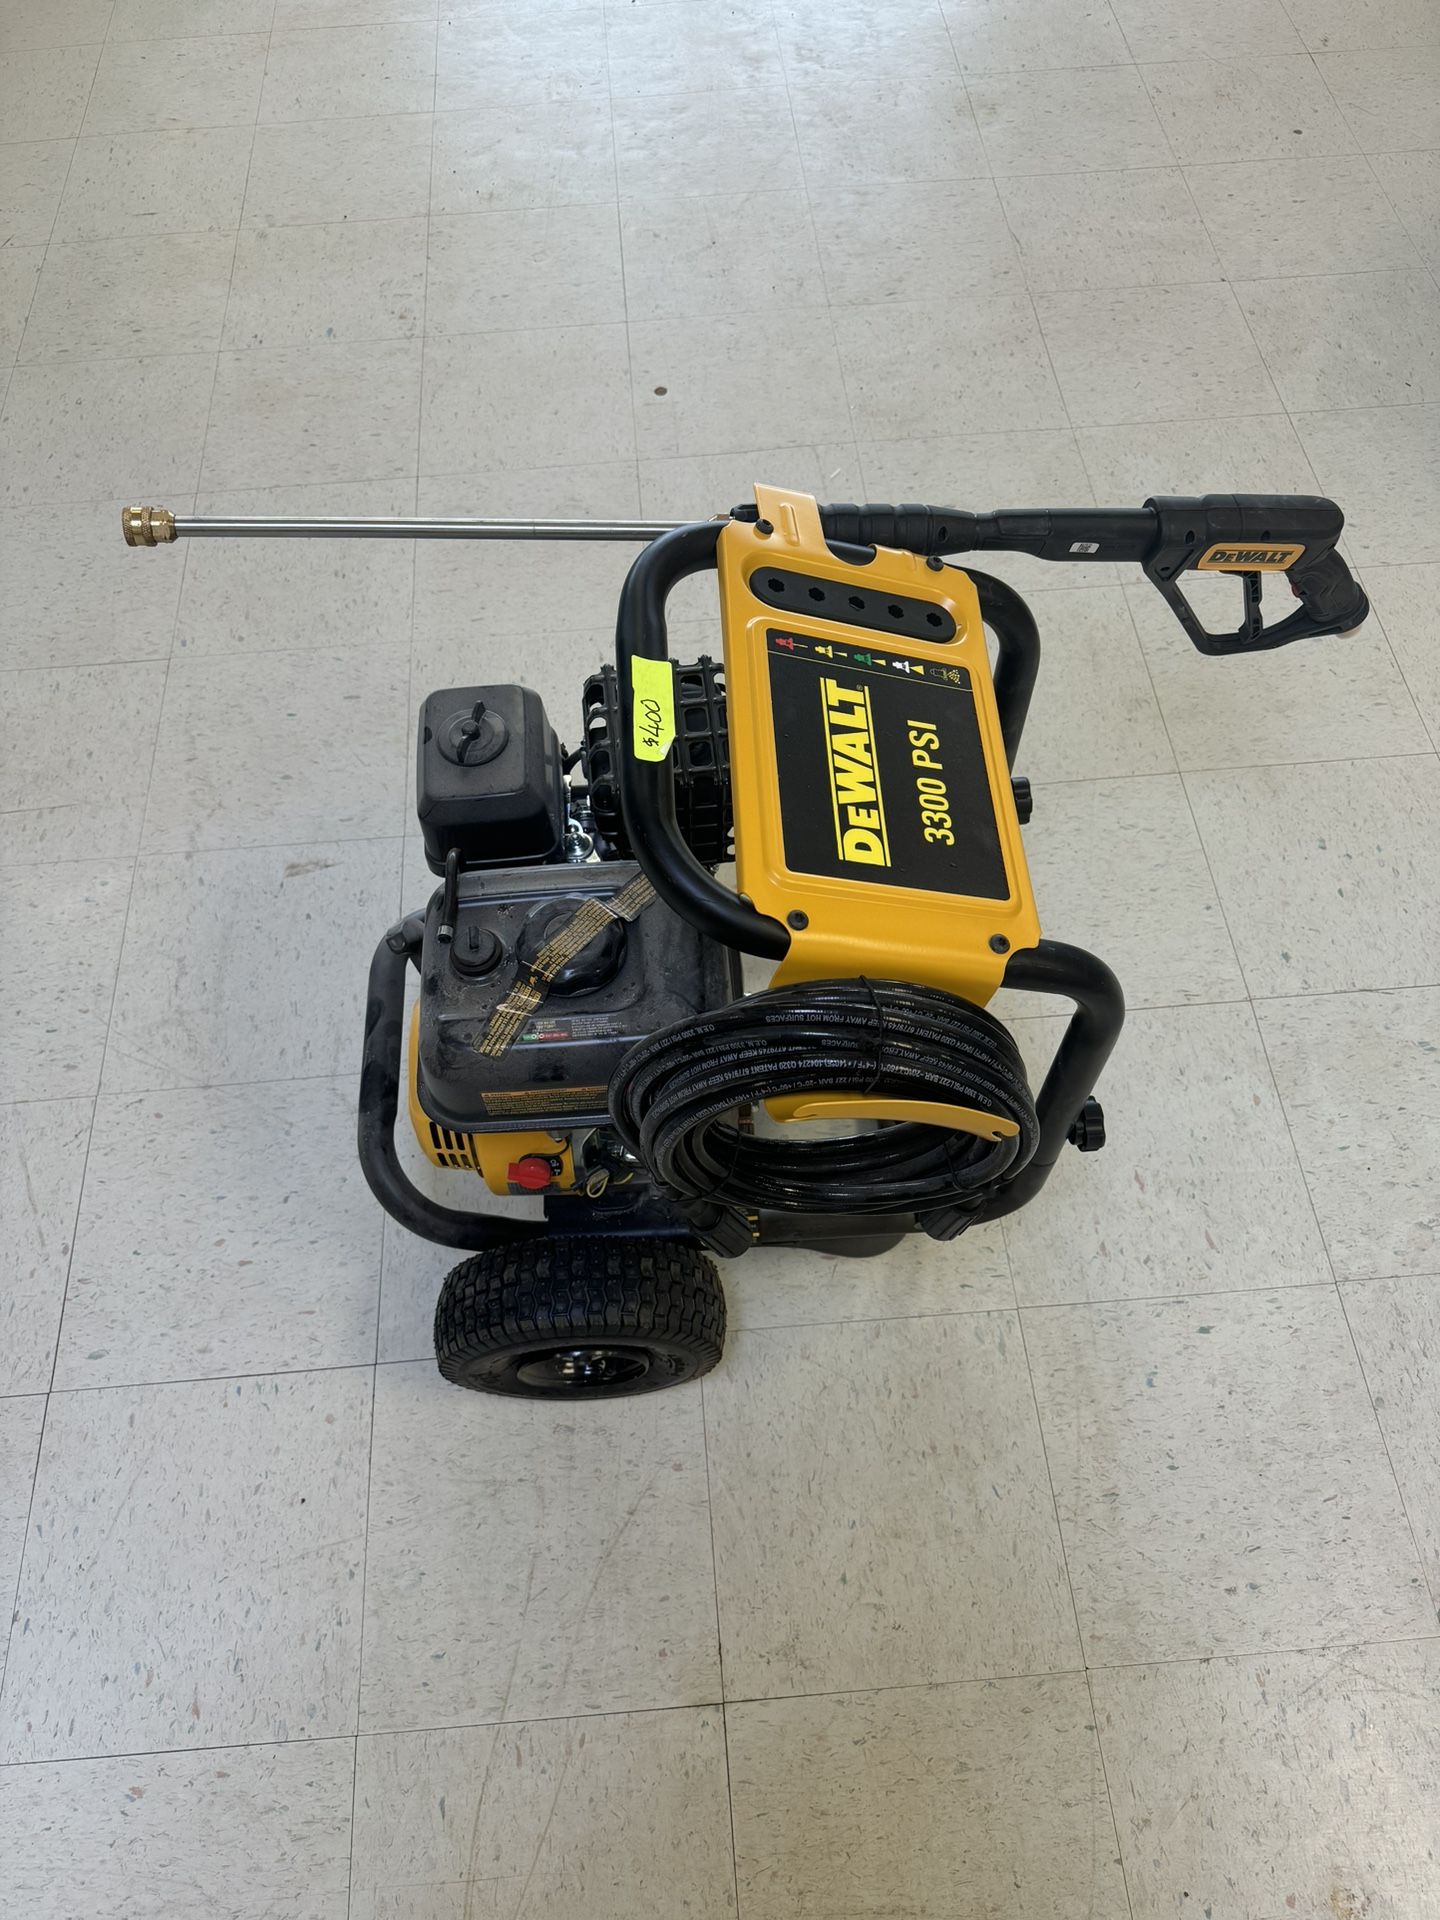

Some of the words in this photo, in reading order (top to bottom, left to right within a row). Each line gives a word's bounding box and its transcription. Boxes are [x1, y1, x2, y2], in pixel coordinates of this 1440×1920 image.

[1206, 550, 1294, 564] DEWALT
[639, 699, 664, 747] $400
[907, 719, 944, 770] PSI
[824, 678, 887, 866] DEWALT
[916, 777, 956, 846] 3300
[765, 1013, 804, 1023] SURFACES
[806, 1014, 822, 1023] HOT
[821, 1014, 844, 1023] FROM
[844, 1015, 867, 1025] AWAY
[915, 1027, 941, 1040] PATENT
[719, 1052, 738, 1065] AWAY
[739, 1048, 758, 1059] KEEP
[899, 1049, 920, 1060] AWAY
[691, 1063, 702, 1074] HOT
[702, 1056, 719, 1070] FROM
[750, 1062, 778, 1074] PATENT
[778, 1060, 797, 1070] Q320
[708, 1073, 724, 1085] KEEP
[924, 1072, 939, 1083] BAR
[691, 1080, 707, 1092] AWAY
[677, 1087, 692, 1099] FROM
